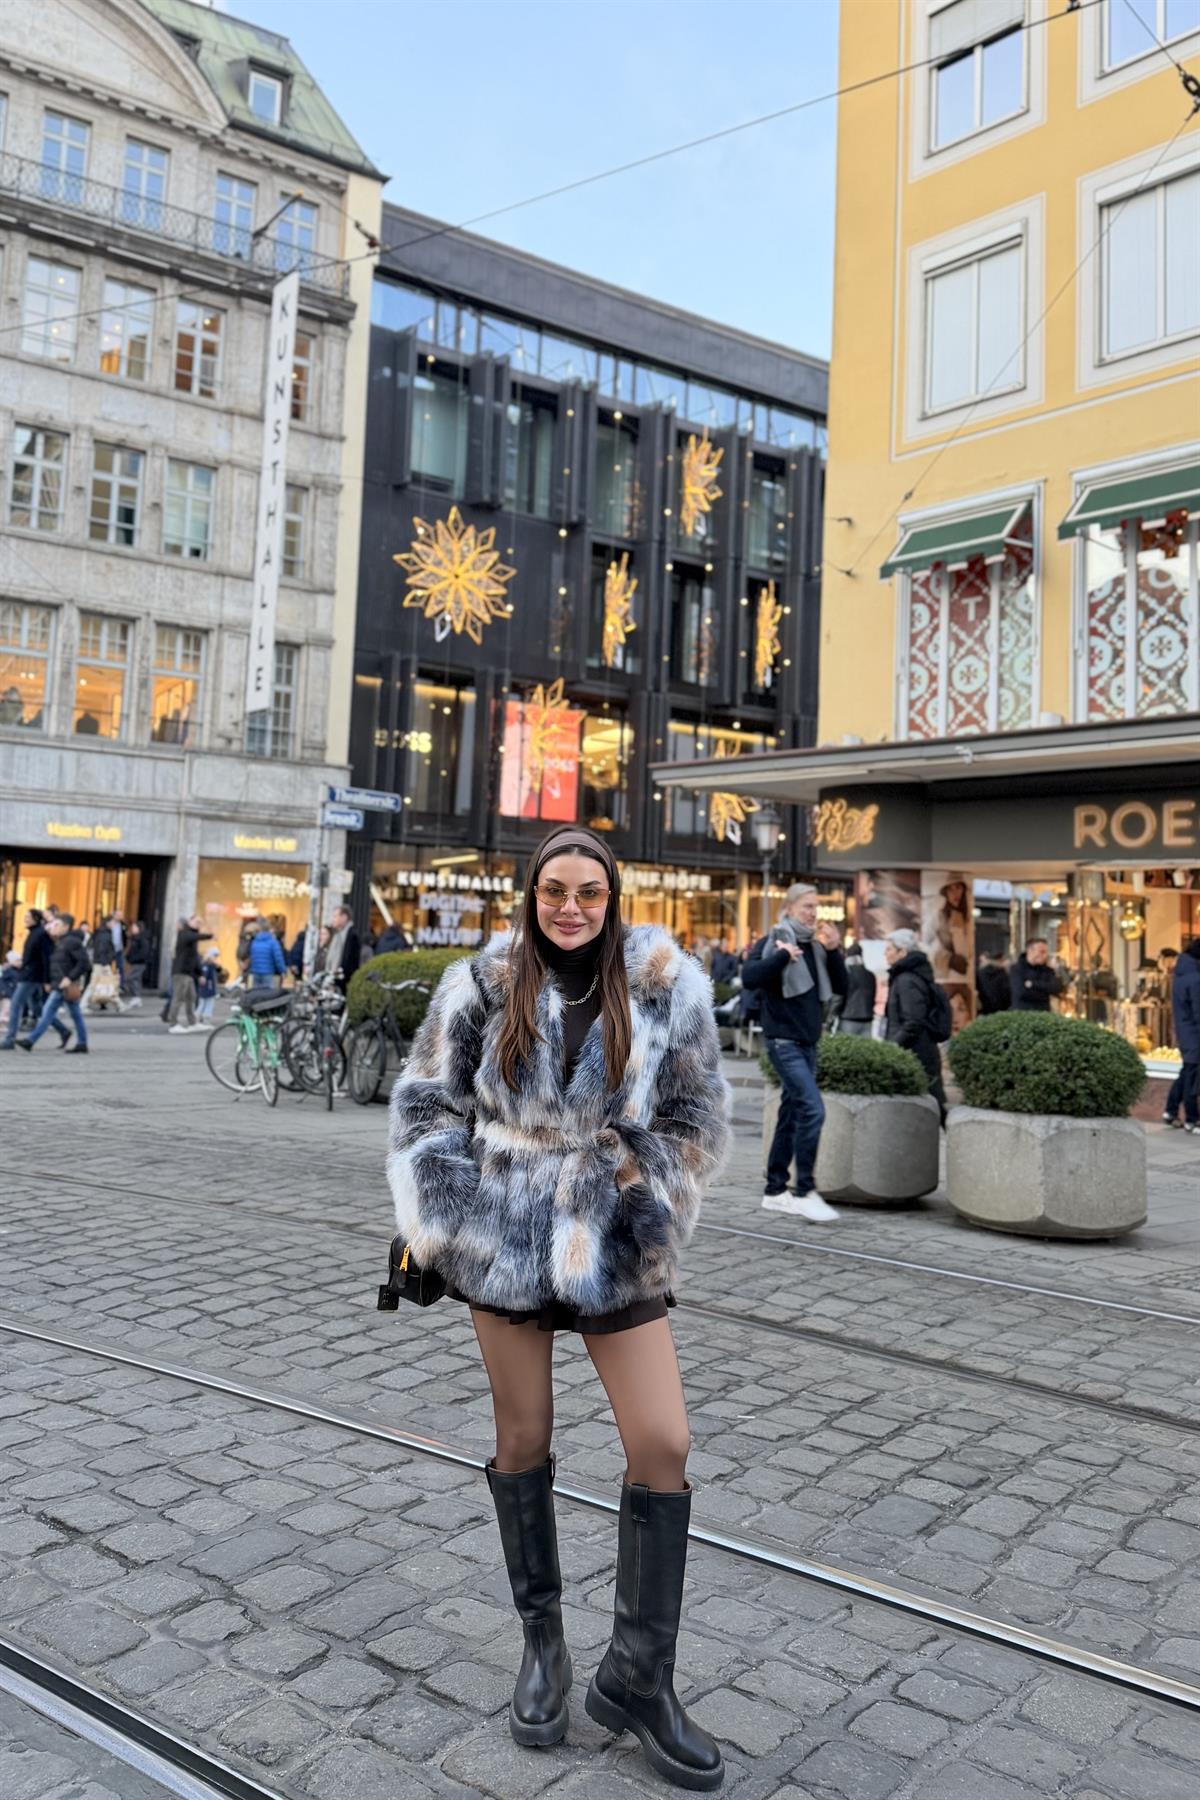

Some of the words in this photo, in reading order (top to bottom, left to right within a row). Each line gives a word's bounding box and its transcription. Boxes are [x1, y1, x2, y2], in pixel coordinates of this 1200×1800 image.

[253, 292, 292, 692] KUNSTHALLE
[1073, 801, 1200, 848] ROE
[397, 870, 513, 892] KUNSTHALLE
[662, 870, 711, 892] HÖFE
